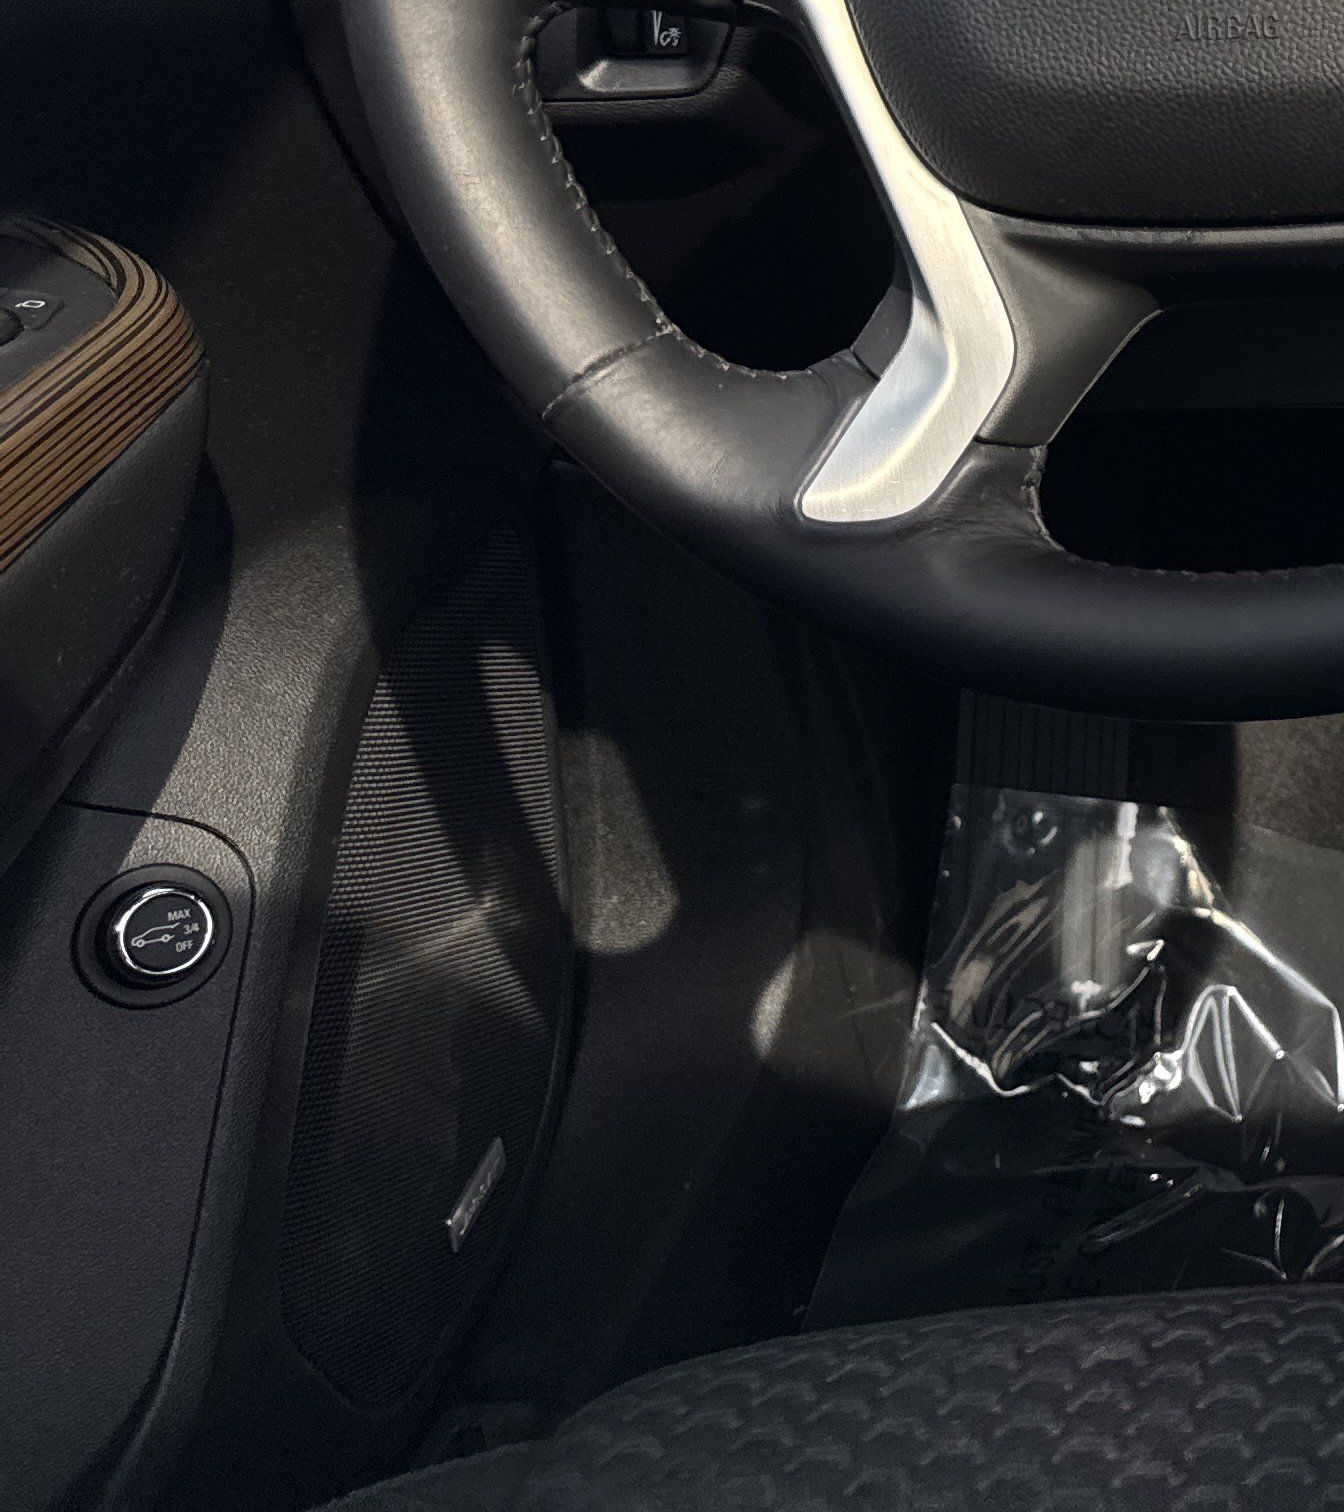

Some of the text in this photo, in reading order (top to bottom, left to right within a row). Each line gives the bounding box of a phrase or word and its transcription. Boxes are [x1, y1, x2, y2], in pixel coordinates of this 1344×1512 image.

[1178, 13, 1280, 40] AIRBAG
[167, 908, 191, 922] MAX
[183, 922, 200, 936] 3/4
[175, 939, 193, 953] OFF
